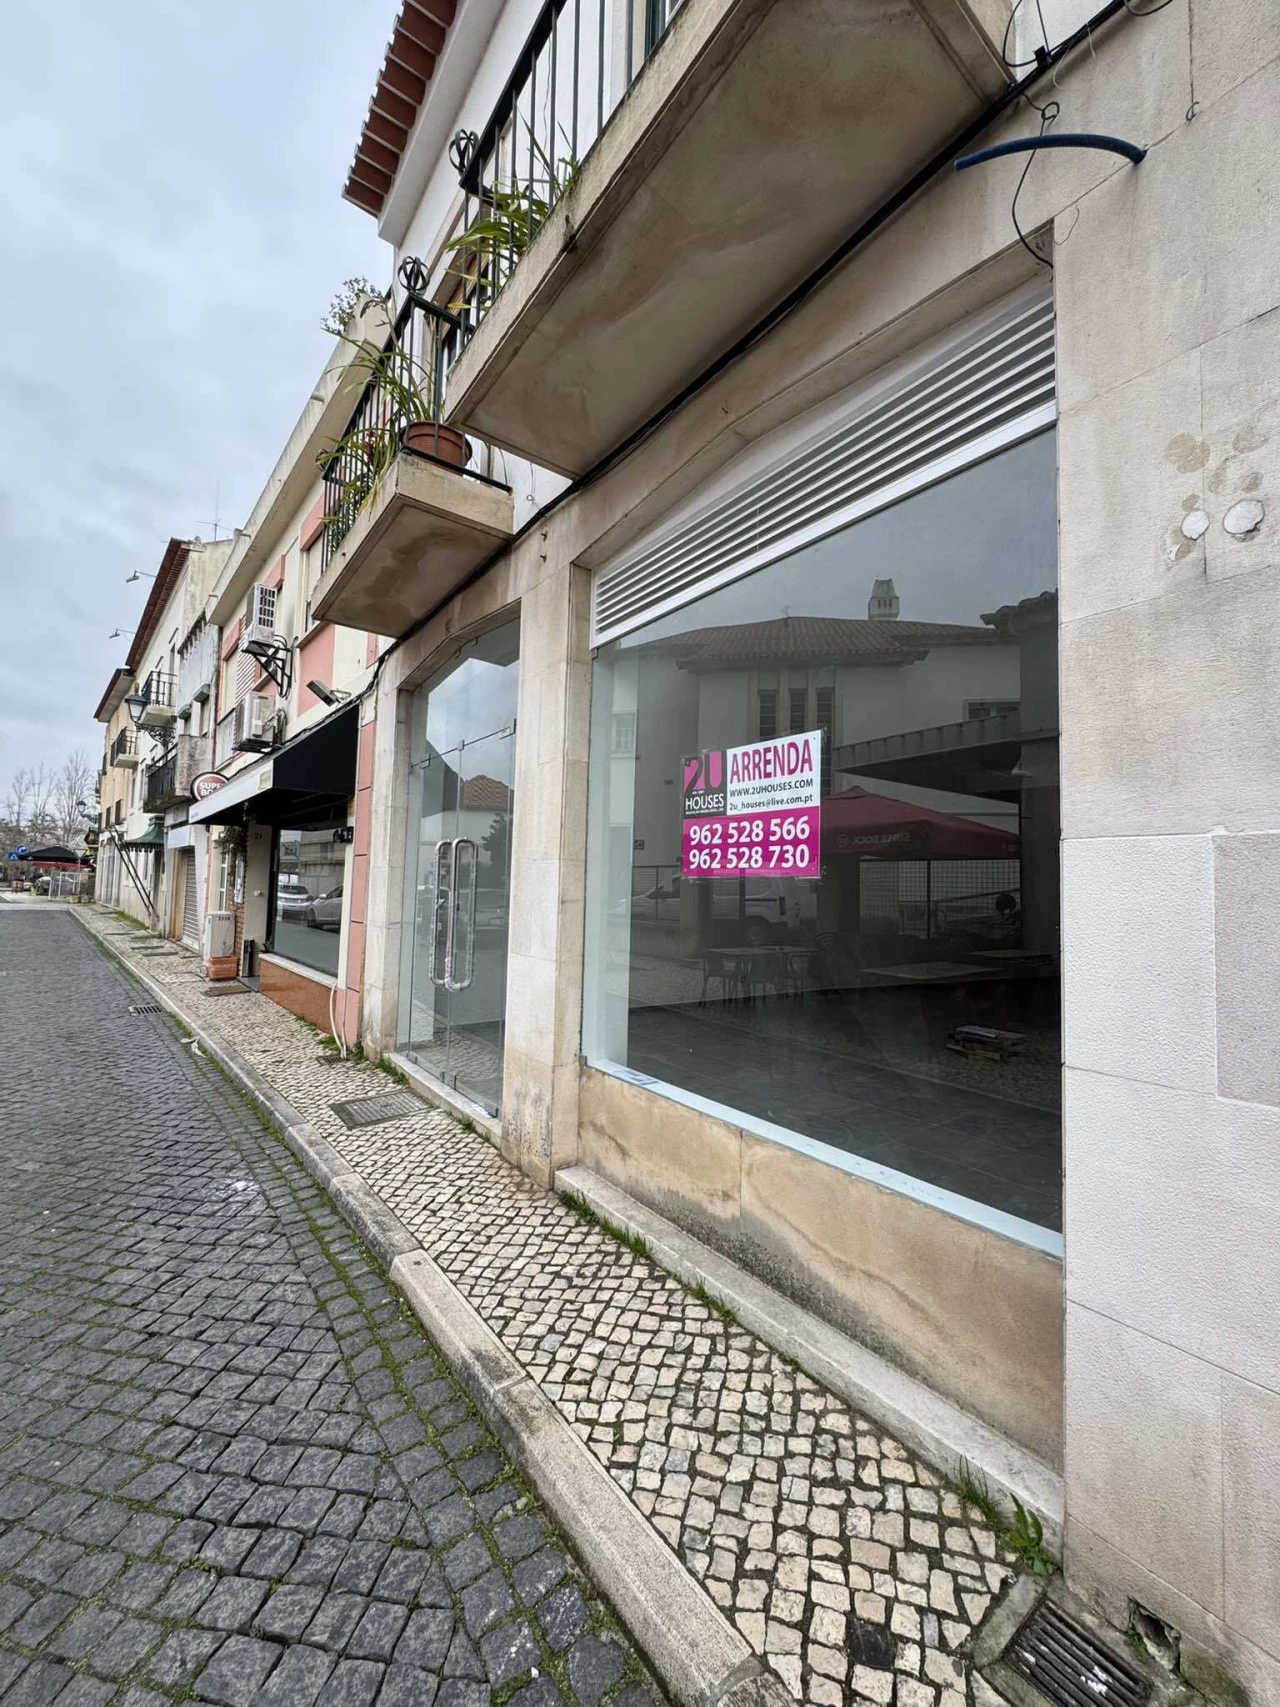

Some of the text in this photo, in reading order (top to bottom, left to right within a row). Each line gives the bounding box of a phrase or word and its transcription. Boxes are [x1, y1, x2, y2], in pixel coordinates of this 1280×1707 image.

[683, 751, 725, 795] 2U
[730, 739, 813, 784] ARRENDA
[199, 781, 224, 790] SUPE
[729, 778, 814, 798] WWW.2UHOUSES.COM
[685, 793, 725, 811] HOUSES
[729, 794, 813, 812] 2u_houses@live.com.pt
[689, 815, 811, 846] 962 528 566
[689, 843, 810, 870] 962 528 730
